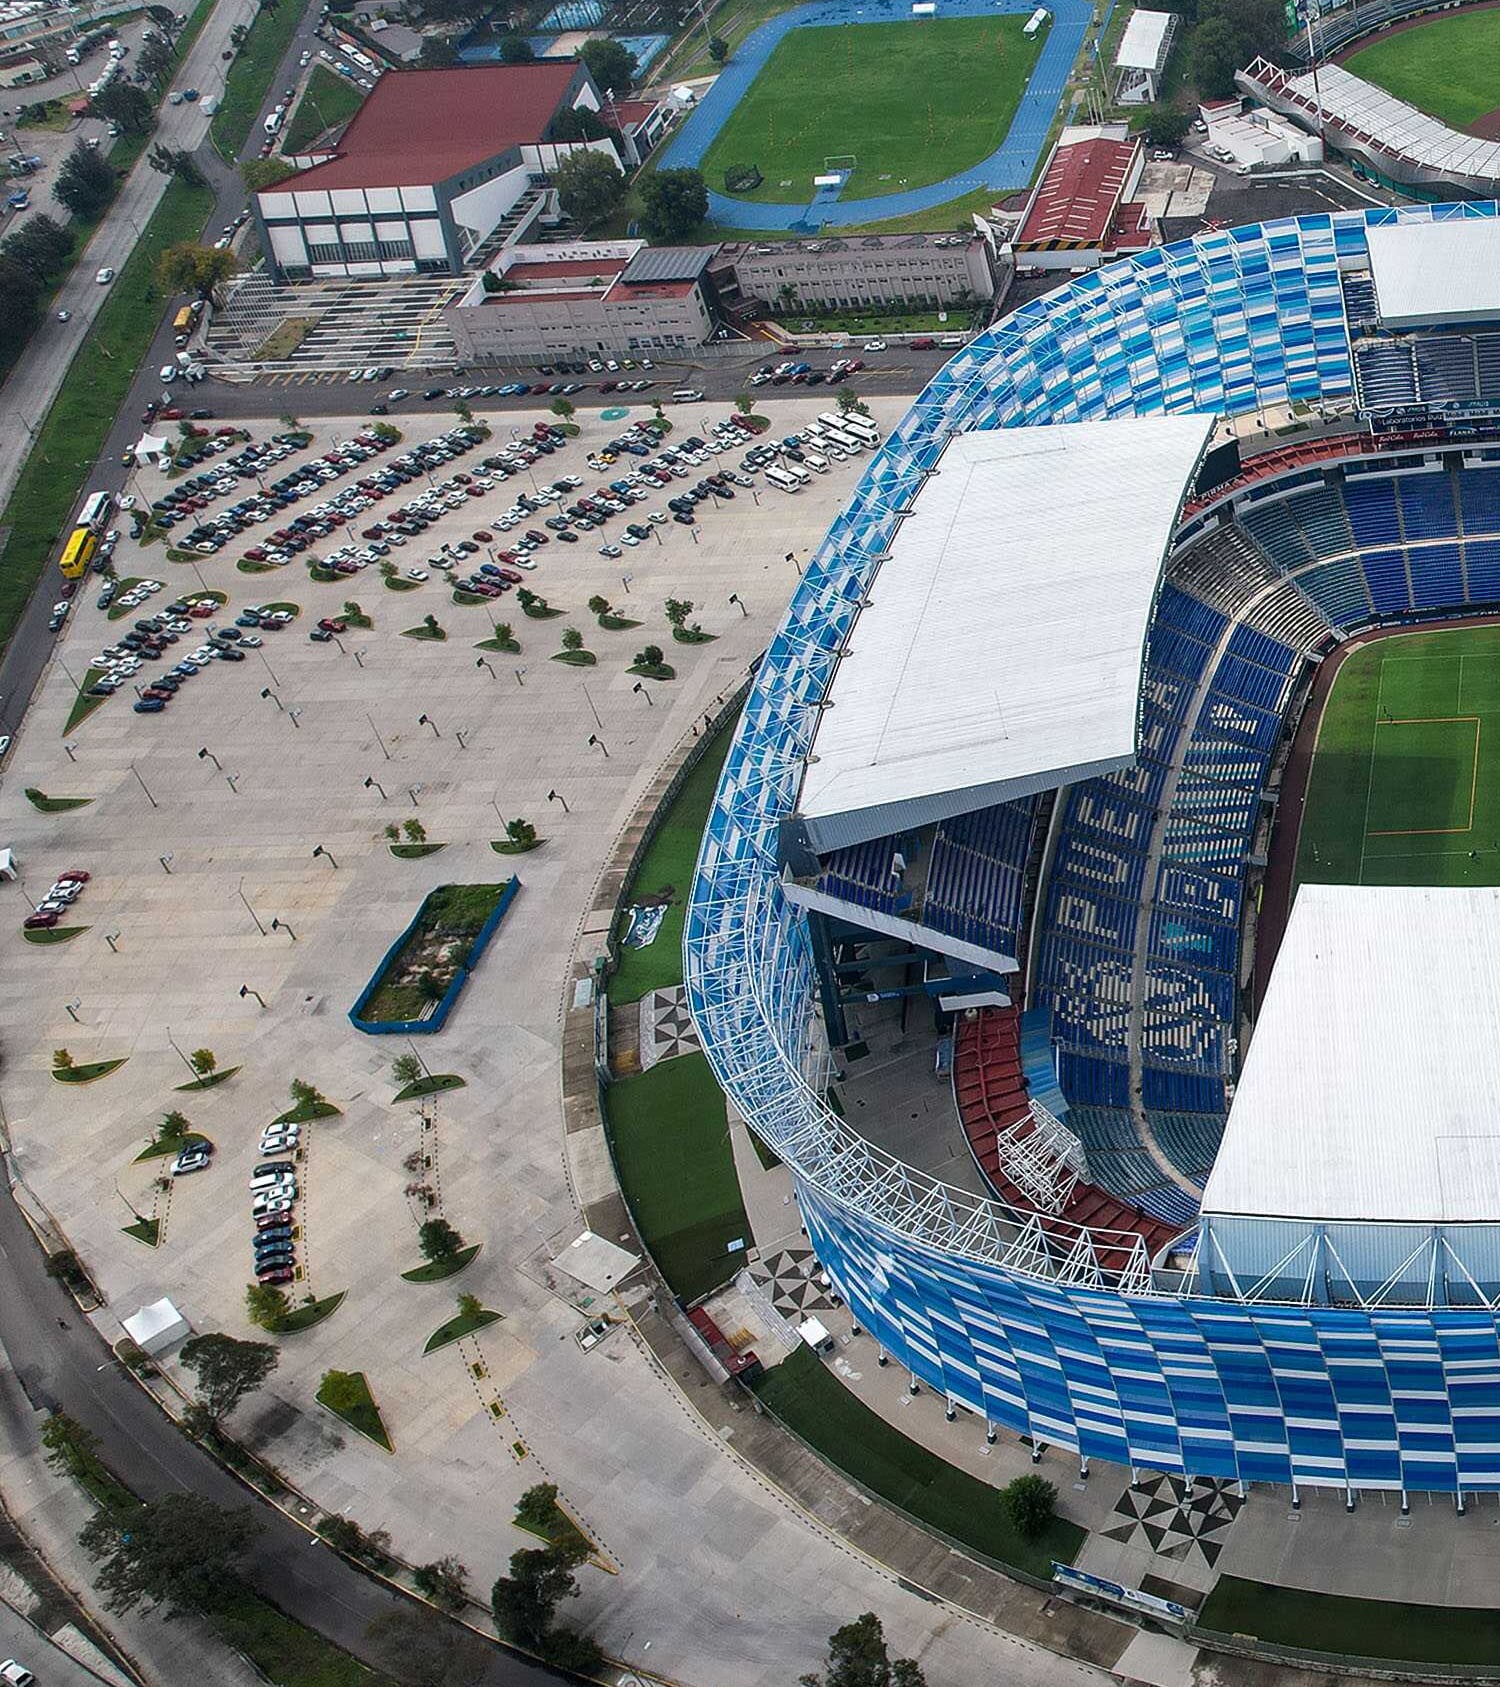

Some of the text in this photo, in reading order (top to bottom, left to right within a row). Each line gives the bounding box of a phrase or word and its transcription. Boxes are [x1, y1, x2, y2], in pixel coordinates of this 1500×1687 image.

[1382, 413, 1443, 425] Laboratorios Ruiz
[1201, 482, 1231, 499] PIRMA
